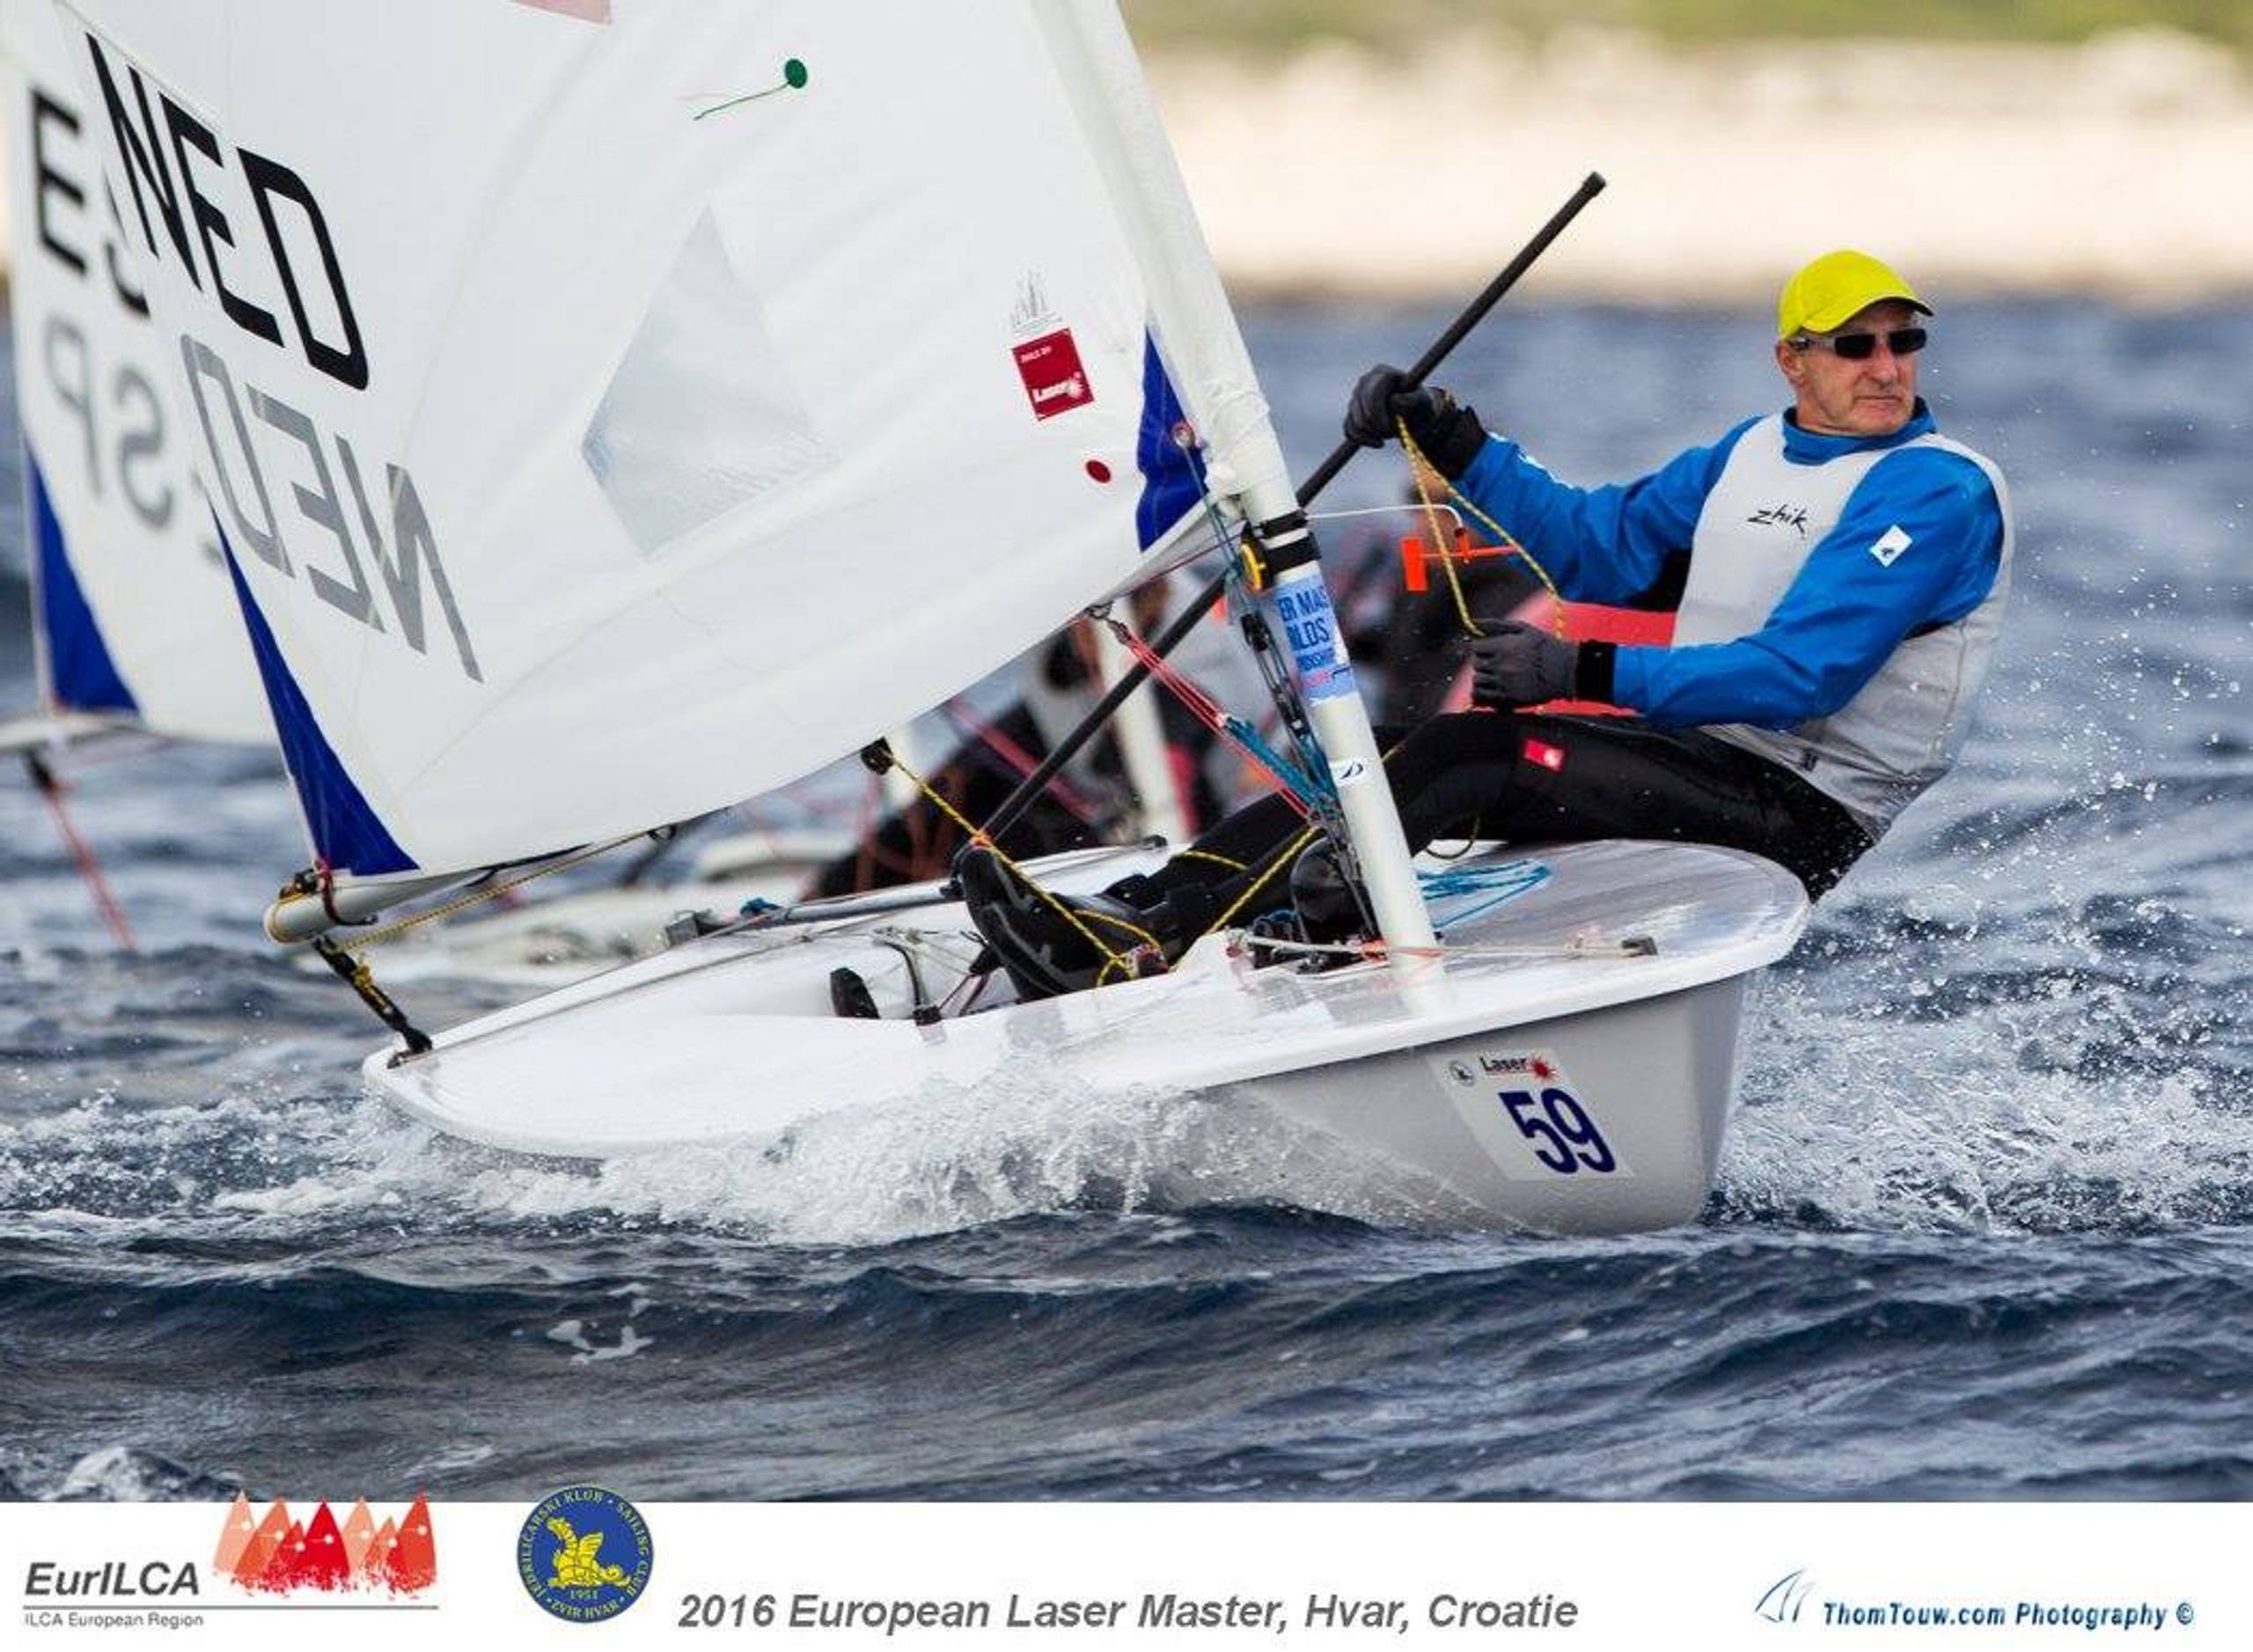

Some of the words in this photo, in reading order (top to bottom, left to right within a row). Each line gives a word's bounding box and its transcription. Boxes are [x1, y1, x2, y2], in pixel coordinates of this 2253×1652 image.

[85, 32, 370, 391] NED
[1747, 503, 1808, 540] zhik
[1479, 1056, 1528, 1072] Laser
[1497, 1088, 1616, 1174] 59
